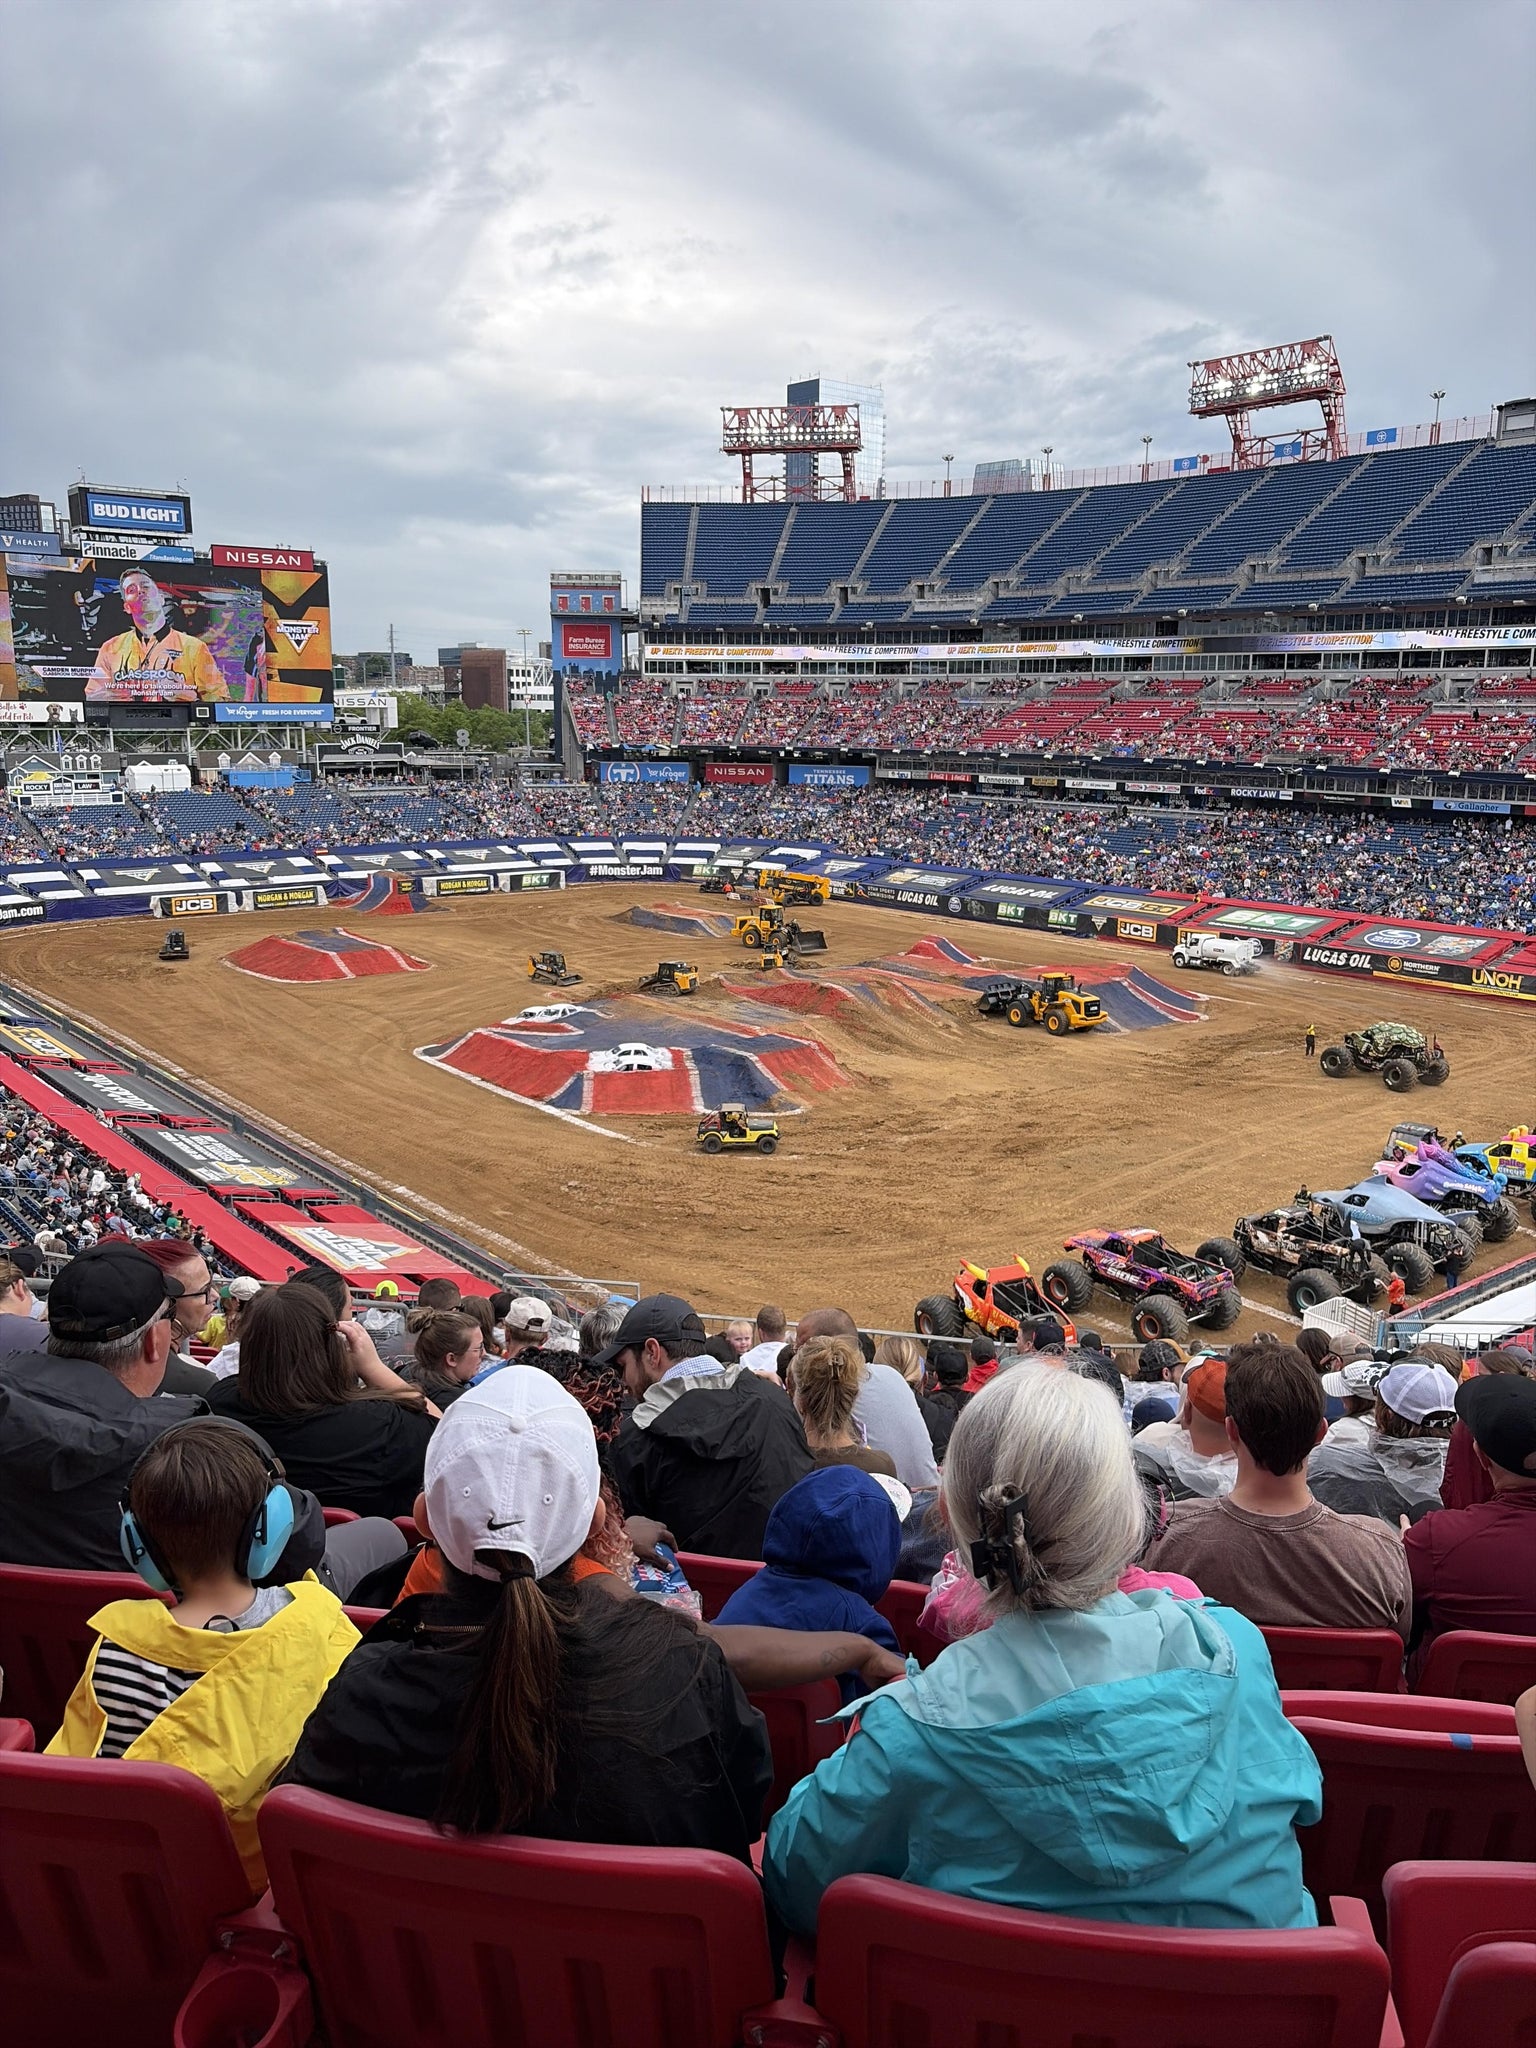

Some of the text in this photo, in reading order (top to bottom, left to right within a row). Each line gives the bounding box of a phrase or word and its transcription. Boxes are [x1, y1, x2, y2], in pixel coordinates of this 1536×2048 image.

[93, 503, 180, 522] BUD LIGHT
[16, 539, 49, 547] HEALTH
[84, 543, 137, 559] Pinnacle
[226, 551, 301, 566] NISSAN
[276, 626, 319, 634] MONSTER
[1454, 629, 1510, 639] FREESTYLE
[289, 632, 309, 641] JAM
[1314, 634, 1373, 646] COMPETITION
[947, 643, 1057, 654] UP NEXT: FREESTYLE COMPETITION
[1112, 639, 1150, 648] FREESTYLE
[1152, 638, 1199, 648] COMPETITION
[651, 647, 661, 655] UP
[726, 648, 774, 656] COMPETITION
[834, 646, 872, 655] FREESTYLE
[874, 647, 918, 655] COMPETITION
[115, 669, 185, 681] CLASSROOM
[334, 698, 387, 706] NISSAN
[236, 706, 258, 719] Kroger
[340, 736, 356, 750] JACK
[660, 766, 685, 781] Kroger
[714, 767, 765, 776] NISSAN
[804, 774, 855, 785] TITANS
[1194, 786, 1214, 795] FedEx
[1230, 788, 1277, 798] ROCKY LAW
[1458, 802, 1500, 812] Gallagher
[589, 864, 663, 877] #MonsterJam
[693, 865, 720, 875] BKT
[440, 880, 462, 890] MORGAN
[467, 879, 488, 888] MORGAN
[522, 874, 550, 885] BKT
[257, 889, 314, 903] MORGAN & MORGAN
[880, 887, 895, 895] SPORTS
[897, 890, 923, 904] LUCAS
[924, 894, 939, 906] OIL
[1093, 898, 1142, 909] JCB
[175, 898, 212, 911] JCB
[998, 904, 1025, 916] BKT
[1049, 911, 1078, 923] BKT
[1120, 922, 1153, 938] JCB
[1303, 947, 1371, 969] LUCAS OIL
[1403, 960, 1440, 971] NORTHERN
[1471, 968, 1522, 990] UNOH
[1100, 1255, 1127, 1269] WILD
[1106, 1267, 1140, 1285] SIDE
